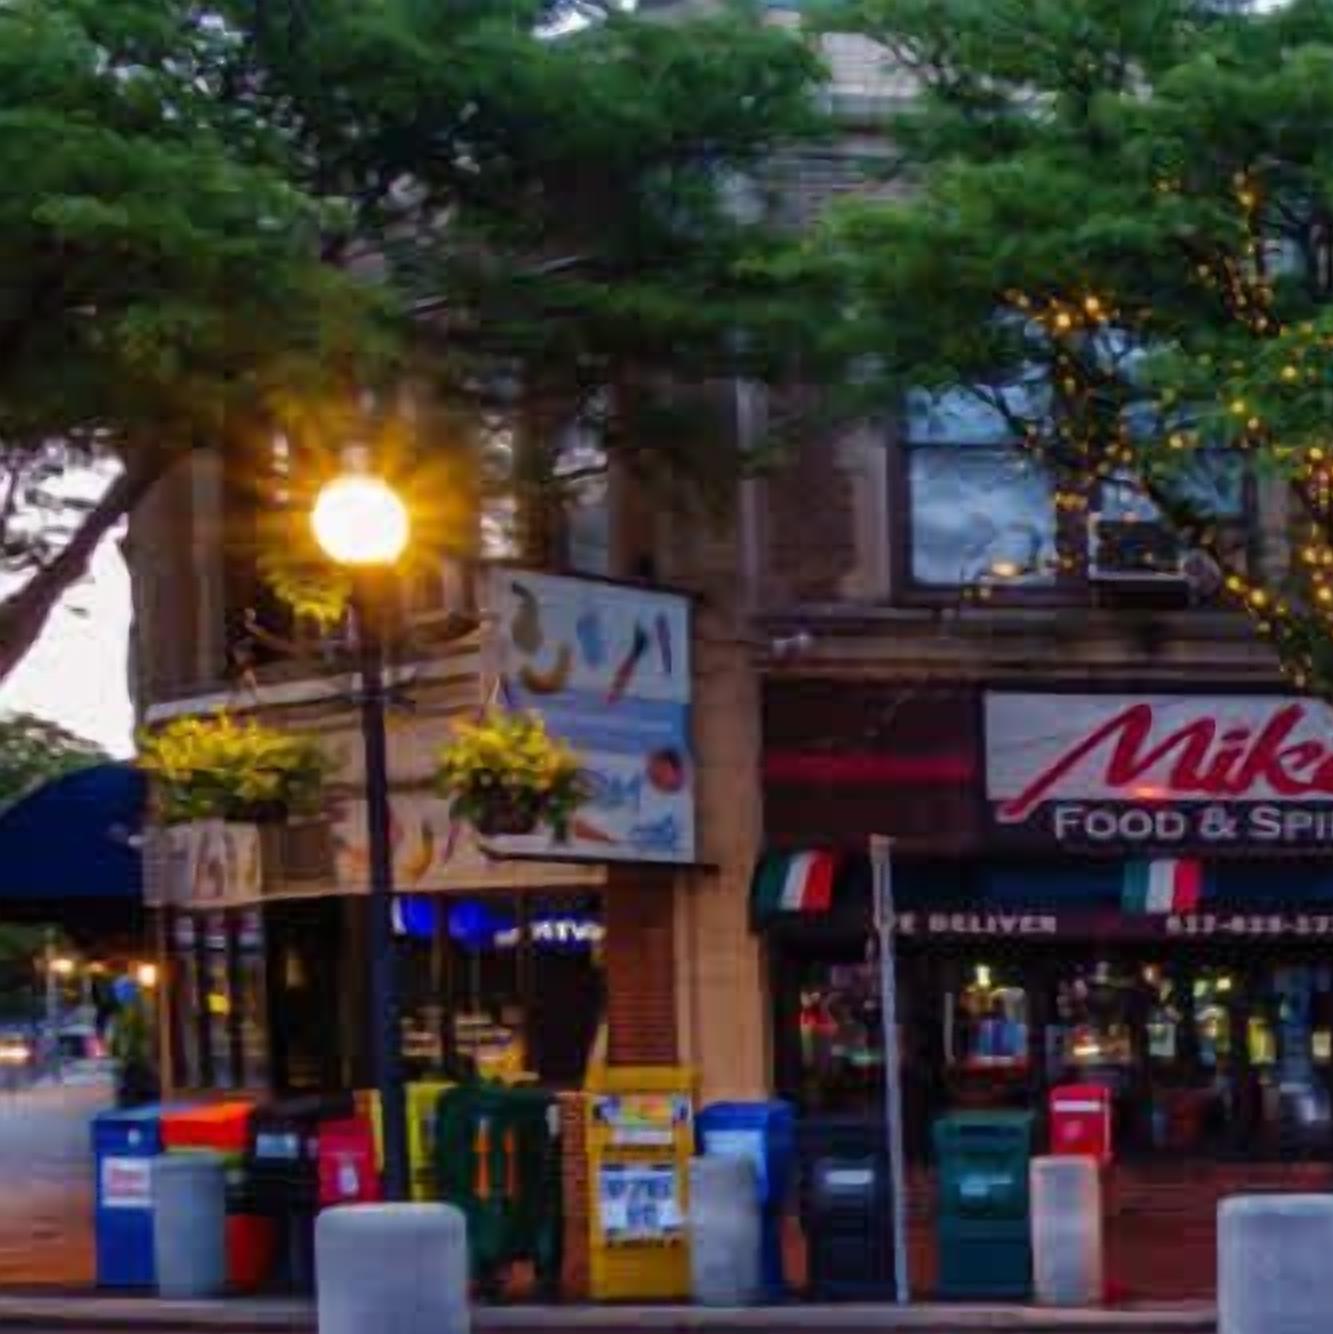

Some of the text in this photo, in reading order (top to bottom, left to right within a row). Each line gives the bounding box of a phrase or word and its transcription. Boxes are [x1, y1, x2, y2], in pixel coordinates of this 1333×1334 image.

[1054, 805, 1186, 840] FOOD
[1199, 805, 1237, 840] &
[928, 911, 1057, 934] DELIVER
